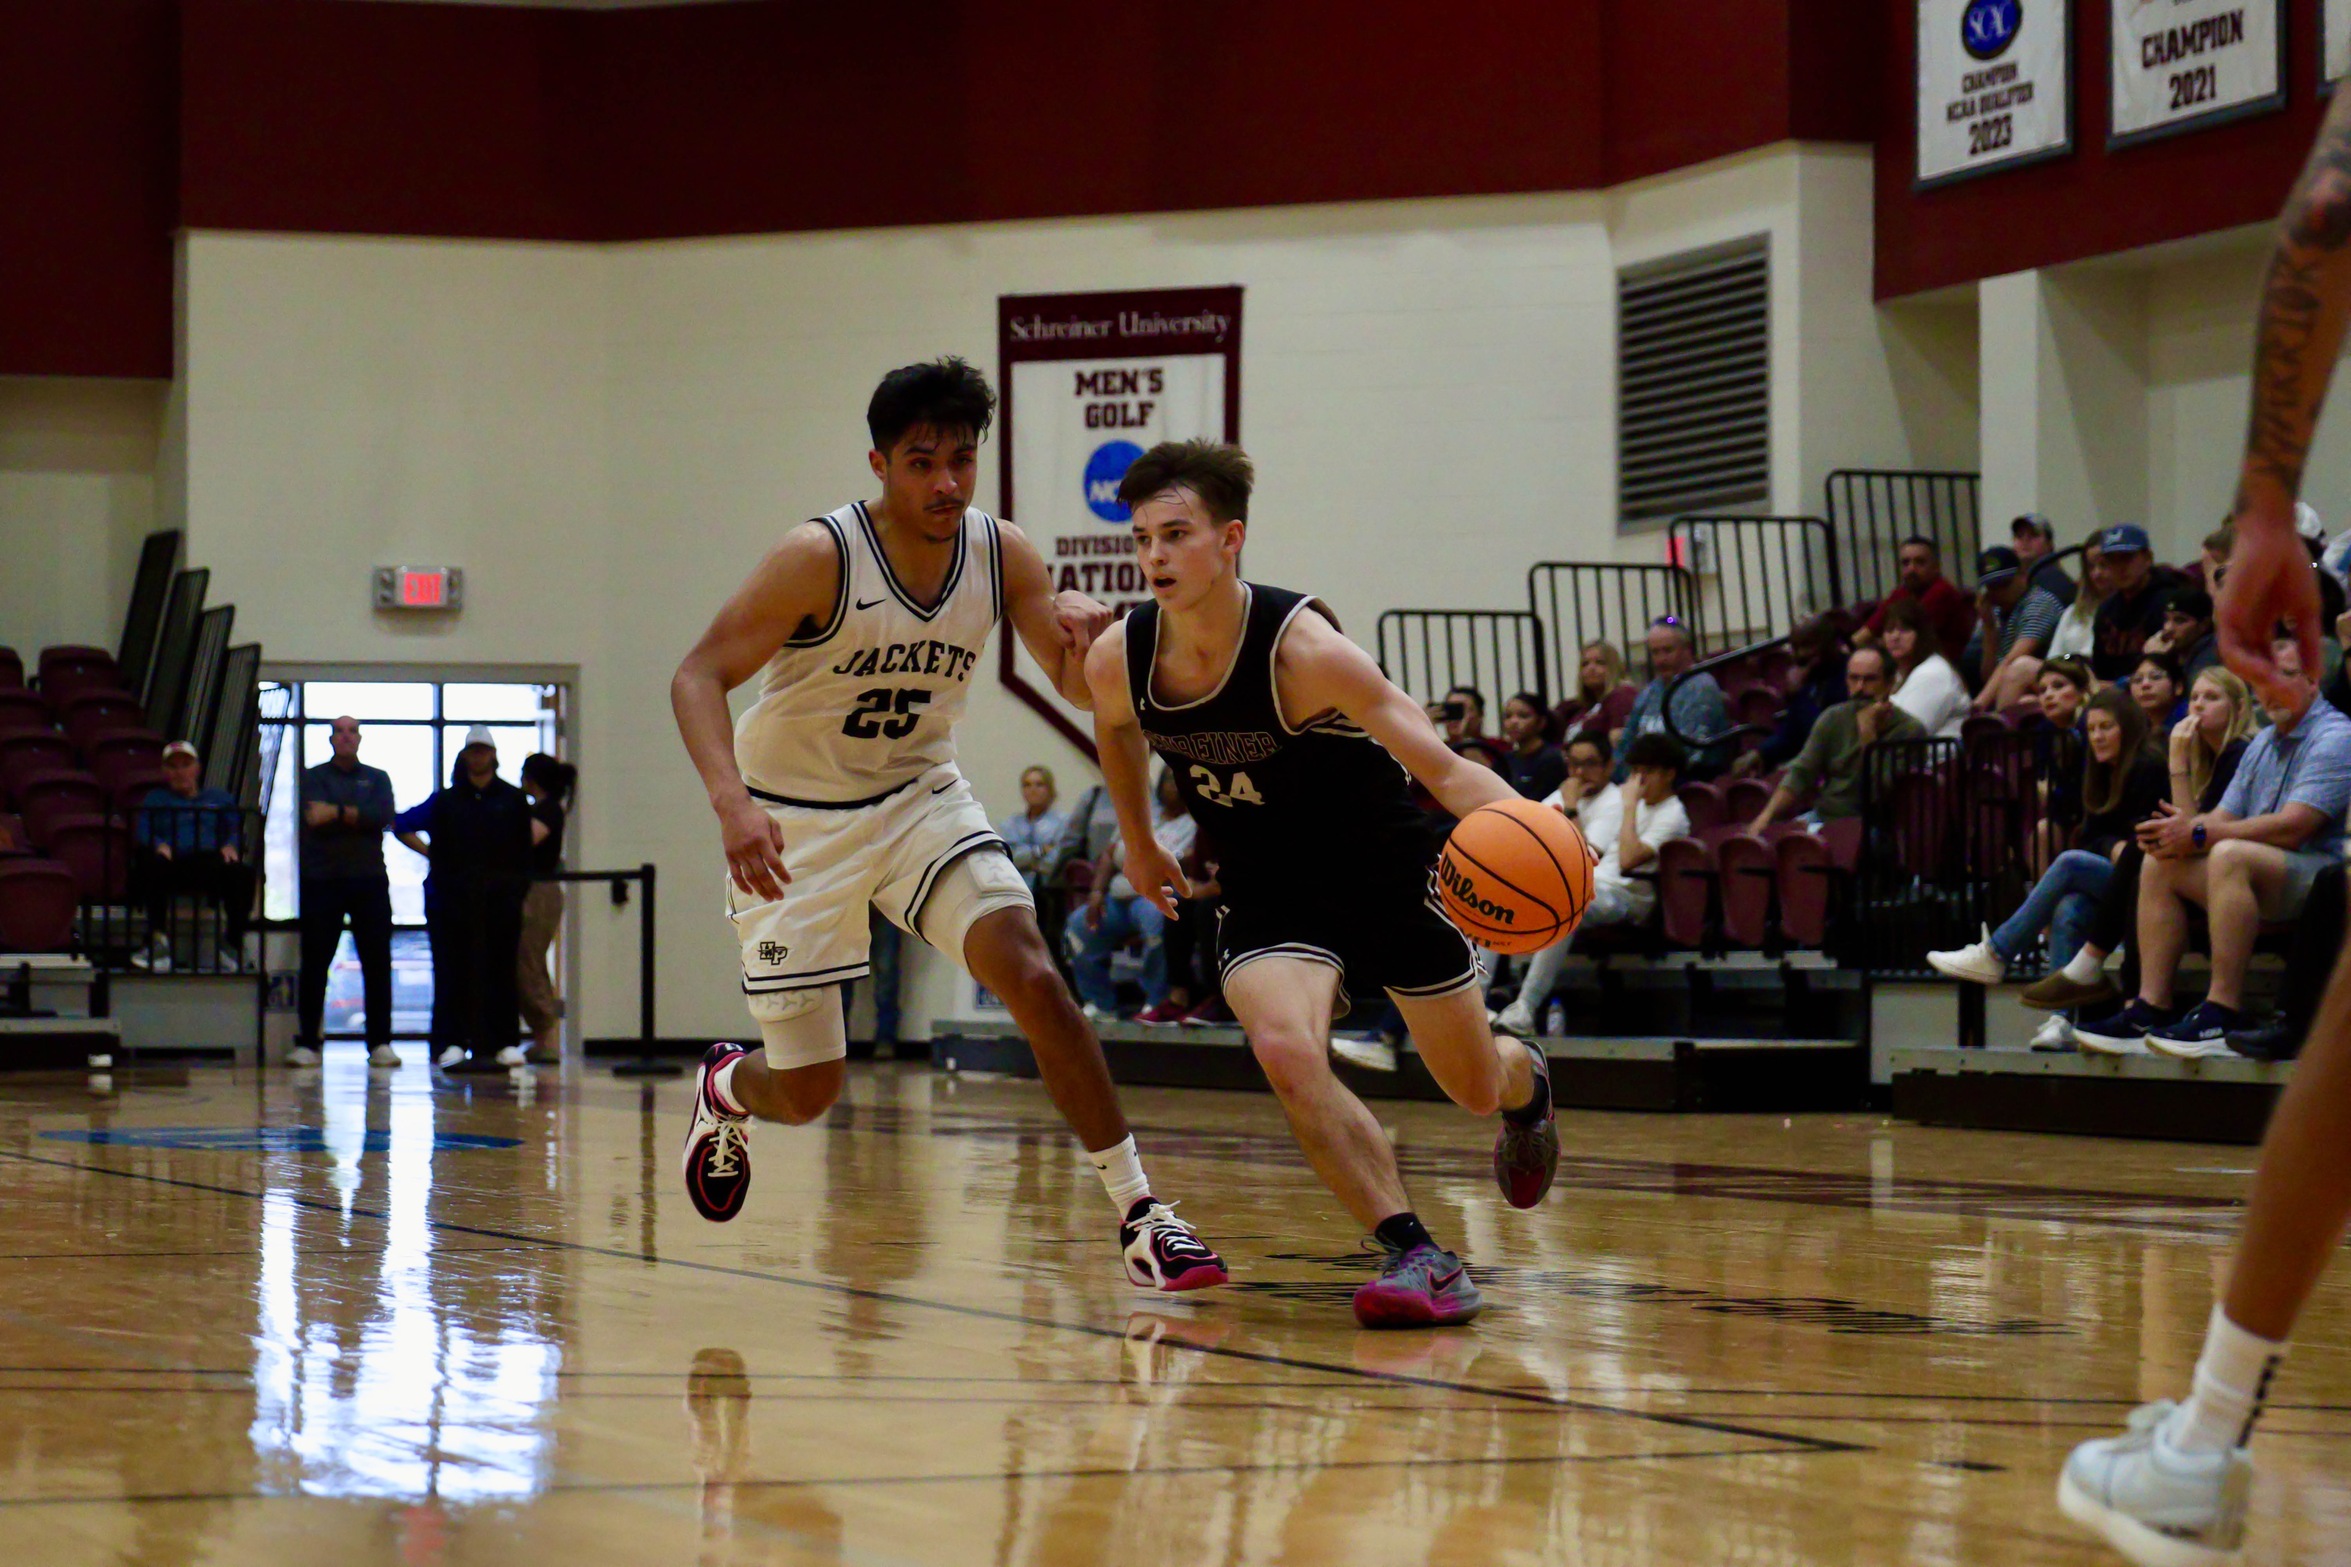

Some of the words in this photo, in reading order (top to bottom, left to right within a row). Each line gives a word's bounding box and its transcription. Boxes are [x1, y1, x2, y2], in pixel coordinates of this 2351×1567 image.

[2142, 10, 2244, 69] CHAMPION
[2169, 64, 2216, 111] 2021
[1968, 113, 2012, 155] 2023
[1010, 314, 1112, 341] Schreiner
[1119, 309, 1230, 343] University
[1075, 368, 1163, 396] MEN'S
[1085, 403, 1153, 428] GOLF
[1055, 536, 1136, 556] DIVISIO
[833, 640, 976, 682] JACKETS
[841, 688, 932, 739] 25
[1189, 764, 1266, 808] 24
[1441, 853, 1515, 925] Wilson
[759, 941, 788, 965] HP
